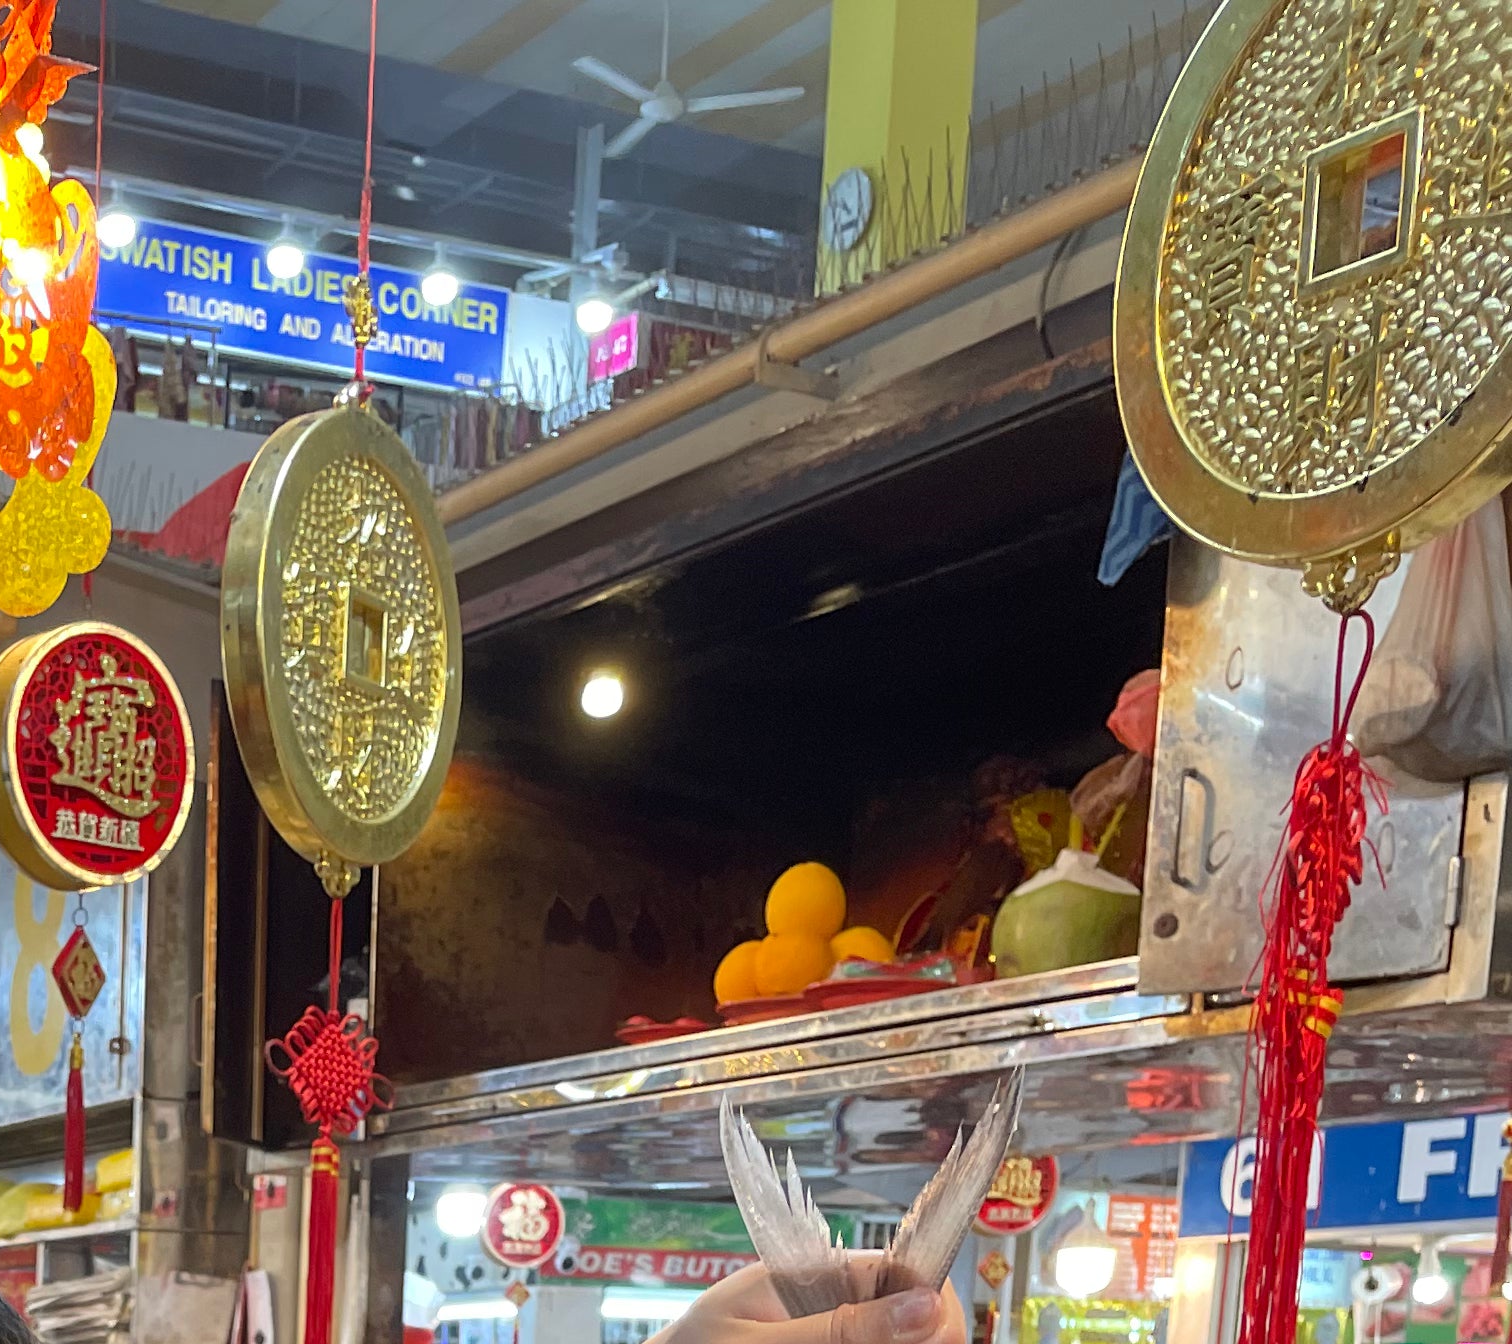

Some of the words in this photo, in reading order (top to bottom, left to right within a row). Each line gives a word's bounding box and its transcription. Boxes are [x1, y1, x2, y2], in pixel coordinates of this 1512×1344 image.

[100, 236, 232, 285] SWATISH
[165, 290, 267, 331] TAILORING
[280, 313, 321, 341] AND
[331, 324, 445, 363] ALERATION
[574, 1251, 653, 1278] OE'S
[662, 1255, 746, 1280] BUTC
